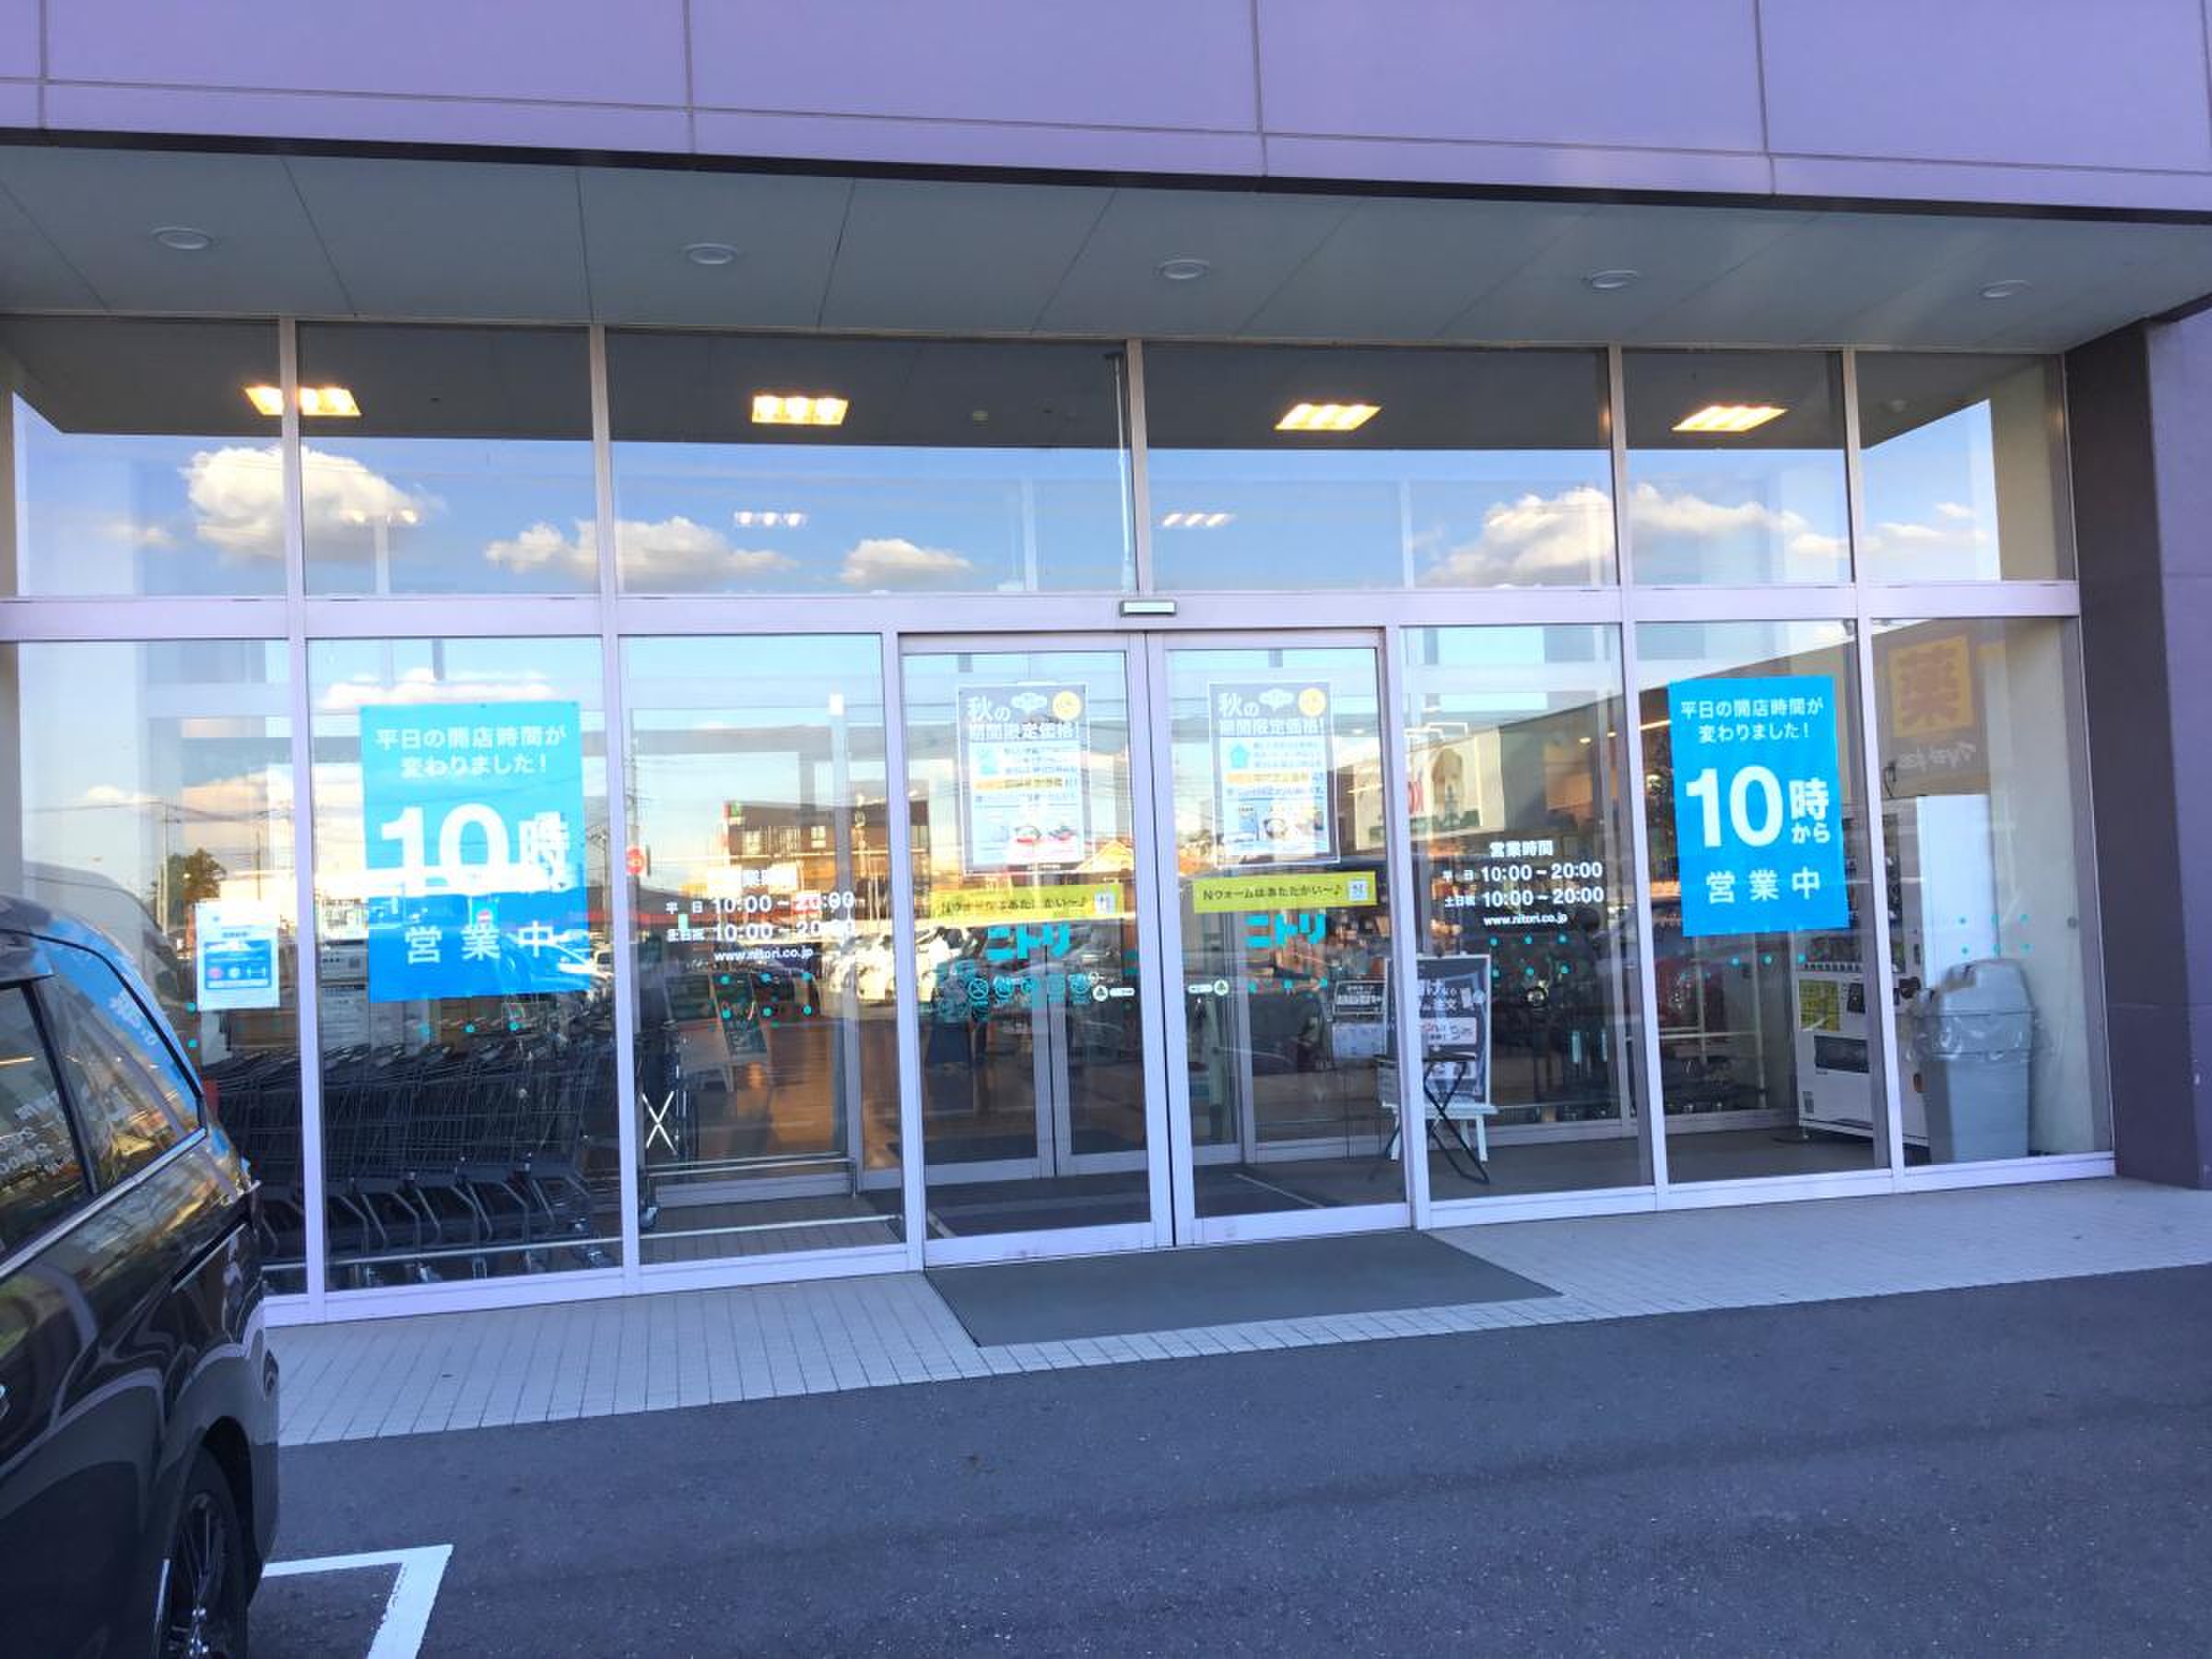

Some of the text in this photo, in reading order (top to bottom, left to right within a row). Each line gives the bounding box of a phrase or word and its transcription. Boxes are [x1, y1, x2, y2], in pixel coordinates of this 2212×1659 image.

[1680, 697, 1824, 719] 平日の開店時間が
[375, 724, 566, 751] 平日の開店時間が
[1698, 722, 1810, 744] 変わりました!
[399, 753, 547, 779] 変わりました!
[1245, 913, 1326, 948] ニトリ
[1483, 912, 1569, 926] www.nitori.co.jp
[713, 946, 814, 961] www.nitori.co.jp
[985, 923, 1071, 960] ニトリ
